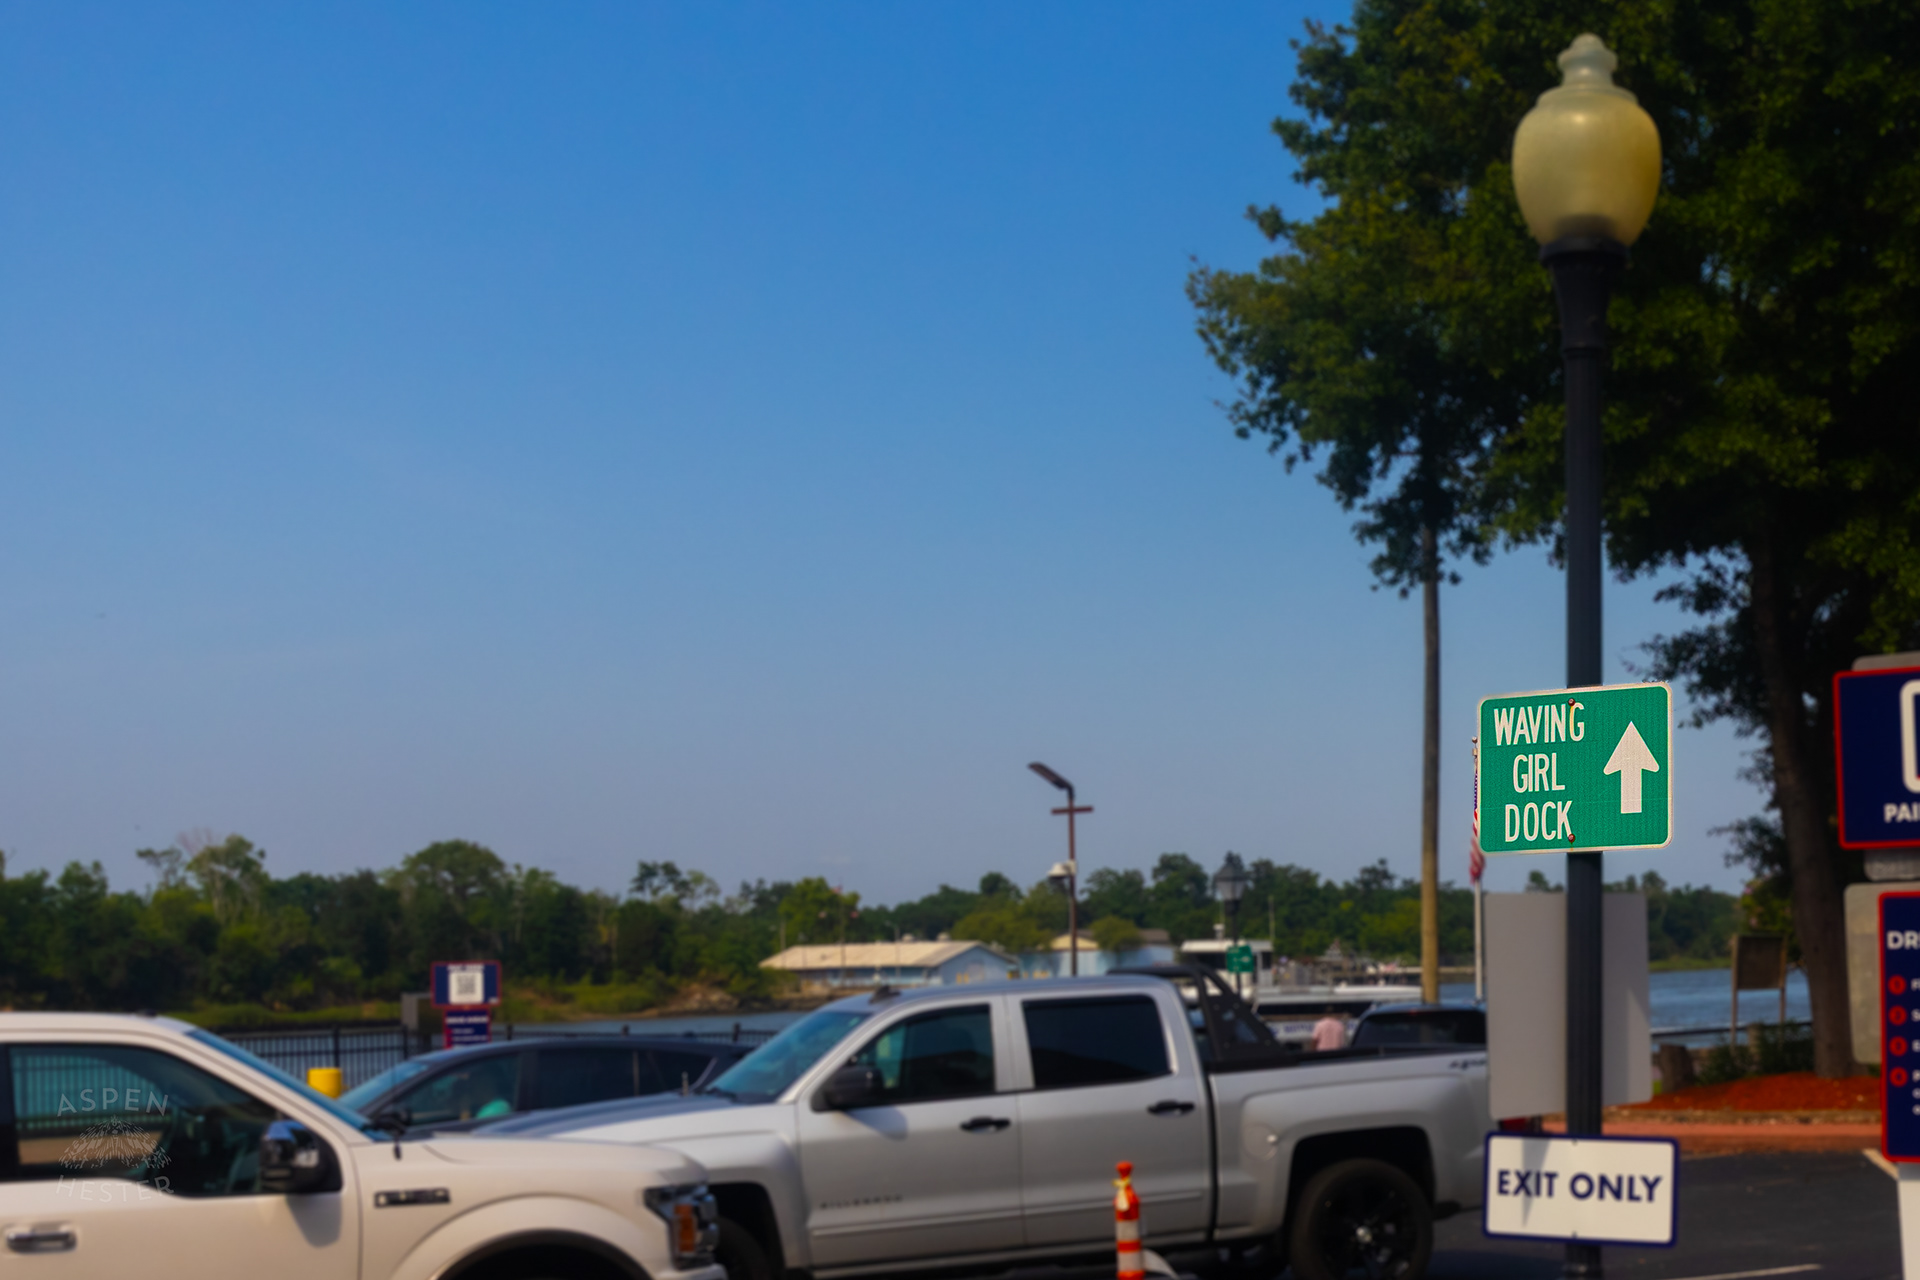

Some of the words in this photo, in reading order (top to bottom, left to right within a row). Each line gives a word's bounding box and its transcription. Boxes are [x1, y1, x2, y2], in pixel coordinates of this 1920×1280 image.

[1493, 702, 1585, 746] WAVING
[1512, 752, 1566, 794] GIRL
[1504, 800, 1574, 843] DOCK
[1497, 1168, 1559, 1199] EXIT
[1569, 1171, 1663, 1203] ONLY
